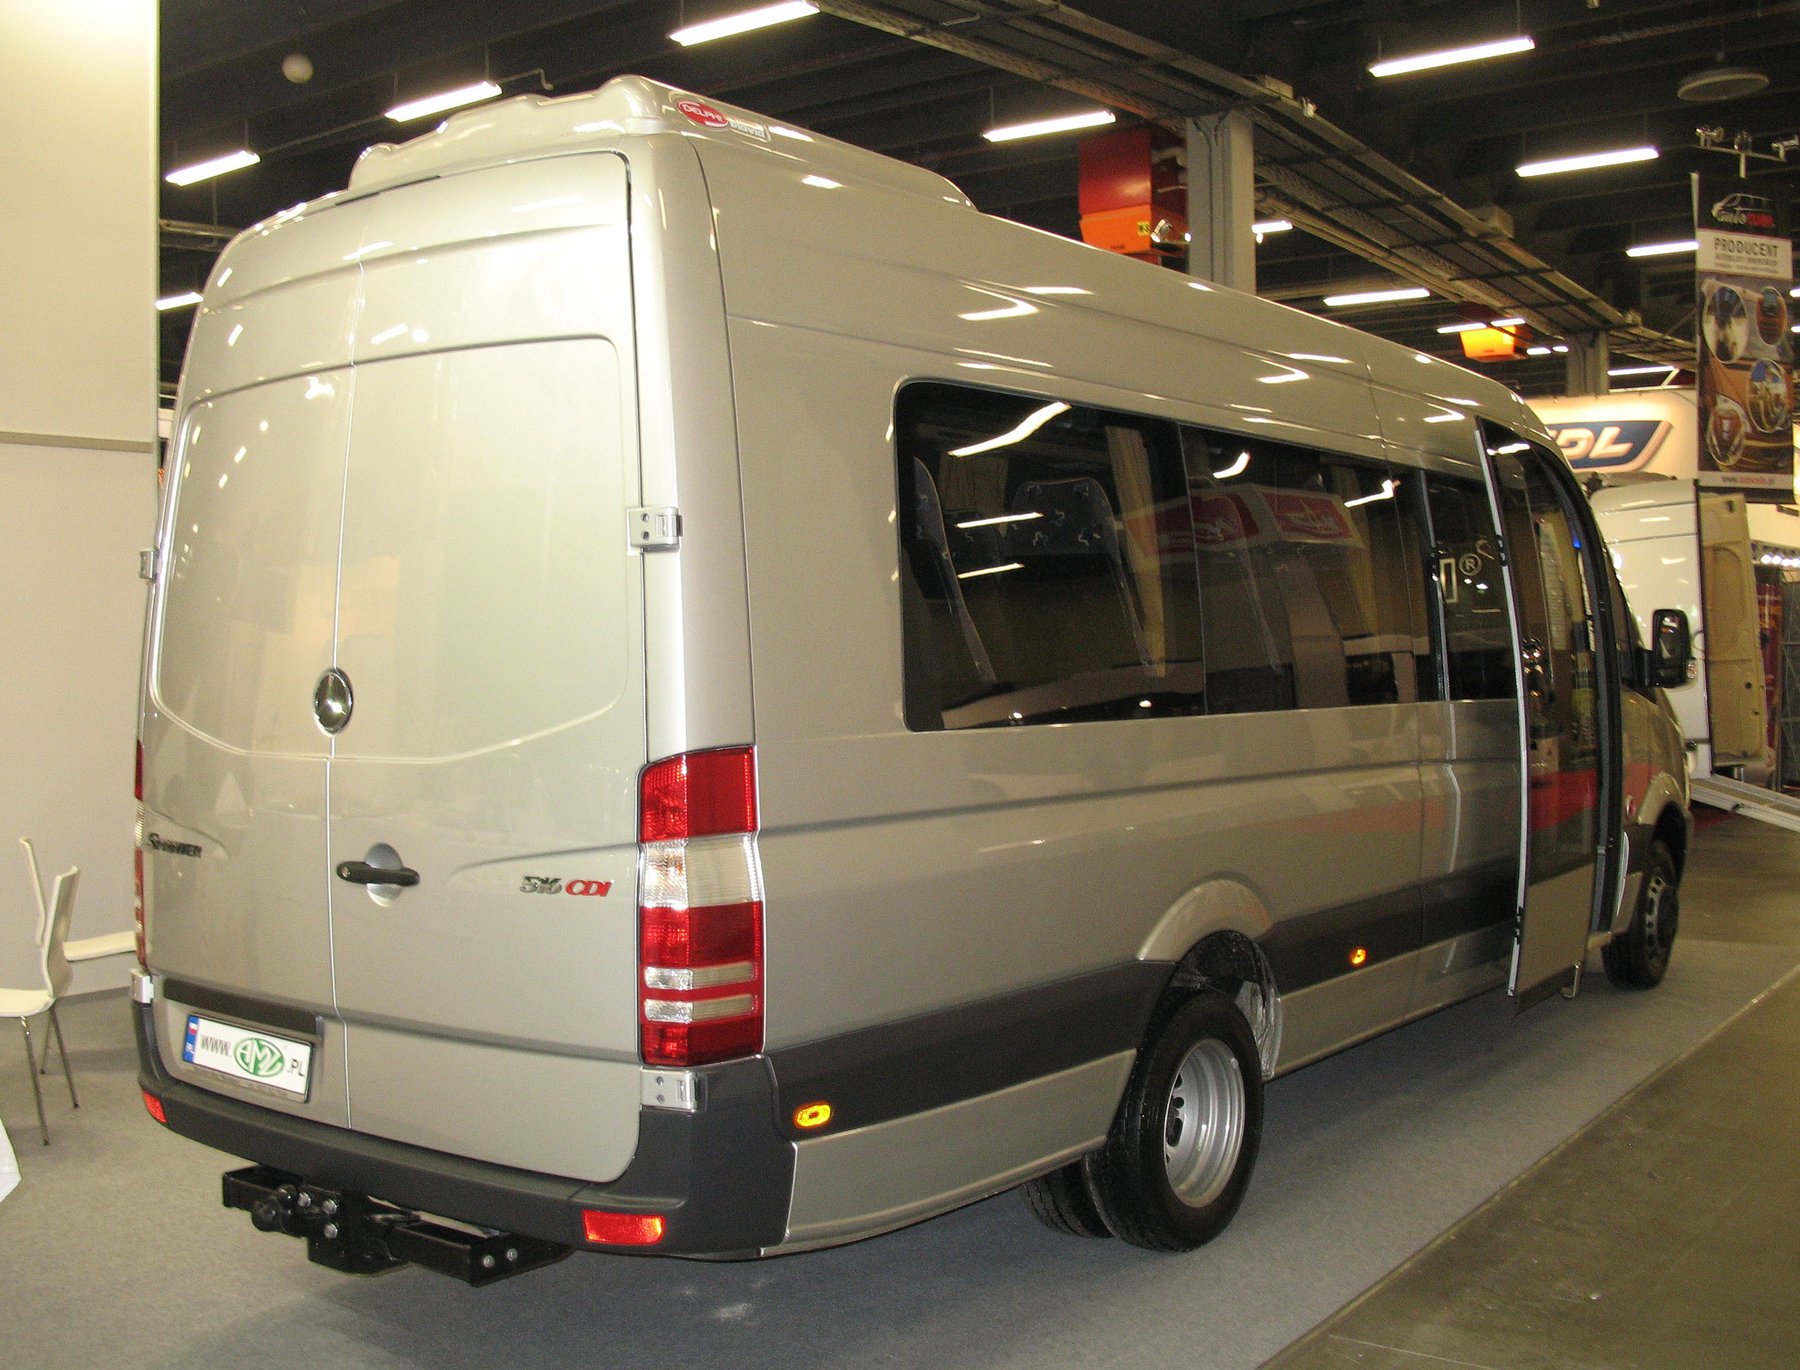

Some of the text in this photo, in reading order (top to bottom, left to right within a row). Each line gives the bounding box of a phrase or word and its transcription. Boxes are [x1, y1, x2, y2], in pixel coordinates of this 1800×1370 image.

[1713, 238, 1779, 258] PRODUCENT
[1550, 426, 1635, 460] DL
[565, 879, 613, 898] CDI
